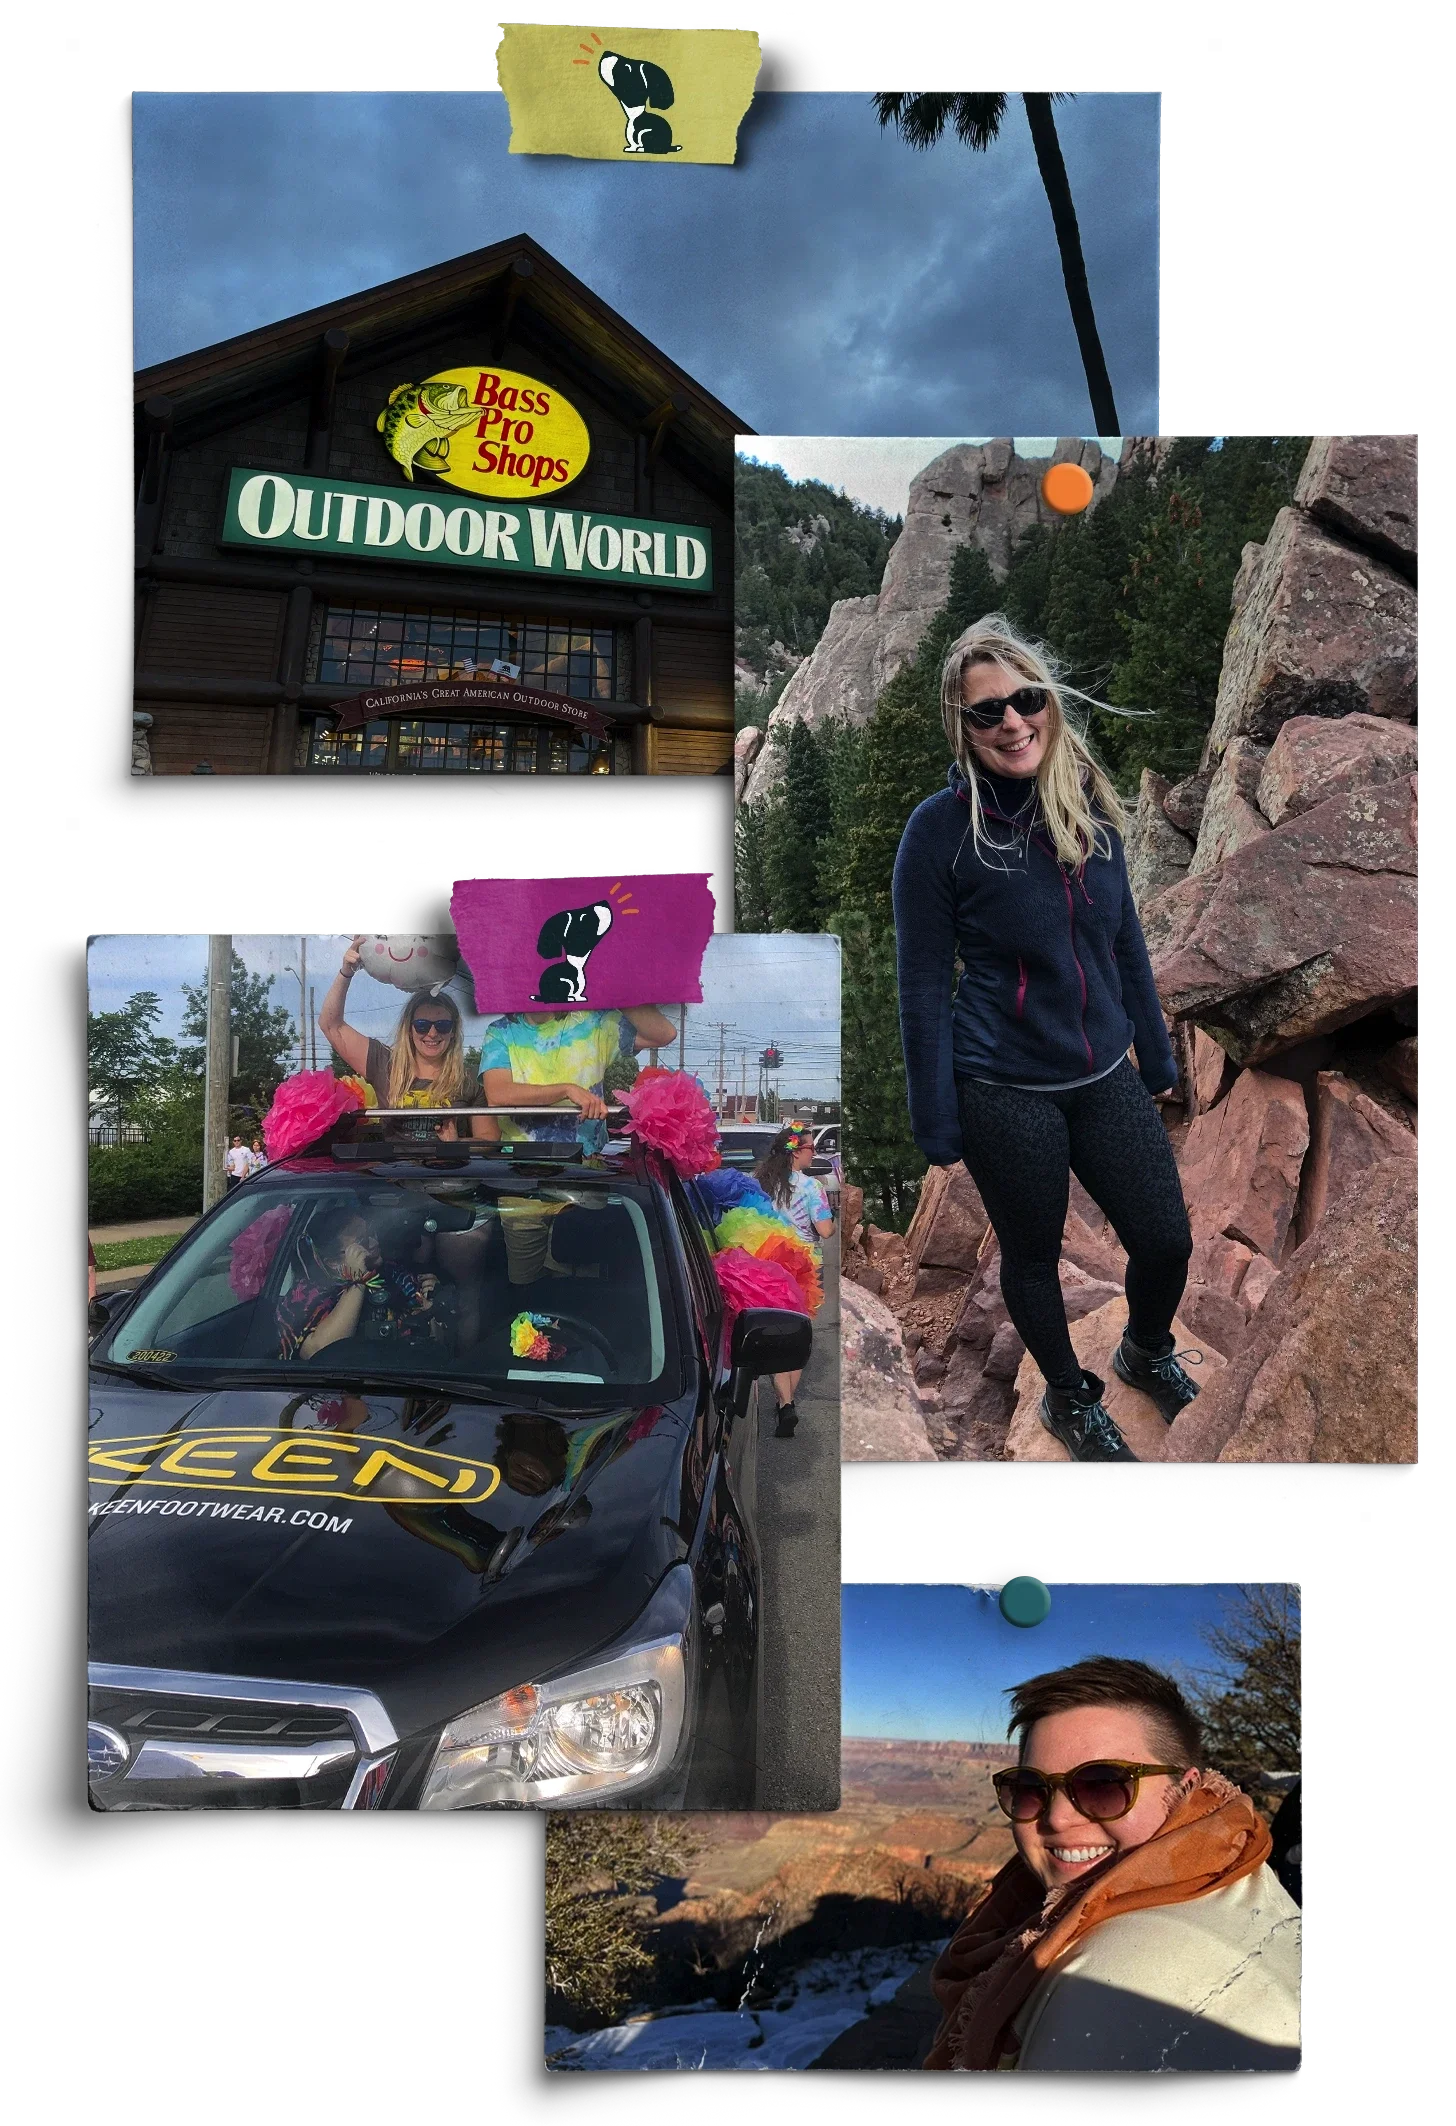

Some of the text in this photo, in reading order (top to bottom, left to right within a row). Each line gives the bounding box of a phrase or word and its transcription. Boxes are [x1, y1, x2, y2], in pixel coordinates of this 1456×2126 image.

[471, 372, 551, 416] Bass
[474, 407, 534, 445] Pro
[472, 440, 570, 488] Shops
[237, 474, 707, 580] OUTDOOR WORLD
[365, 687, 589, 720] CALIFORNIA'S GREAT AMERICAN OUTDOOR STORE
[88, 1436, 477, 1493] KEEN
[88, 1499, 353, 1535] KEENFOOTWEAR.COM
